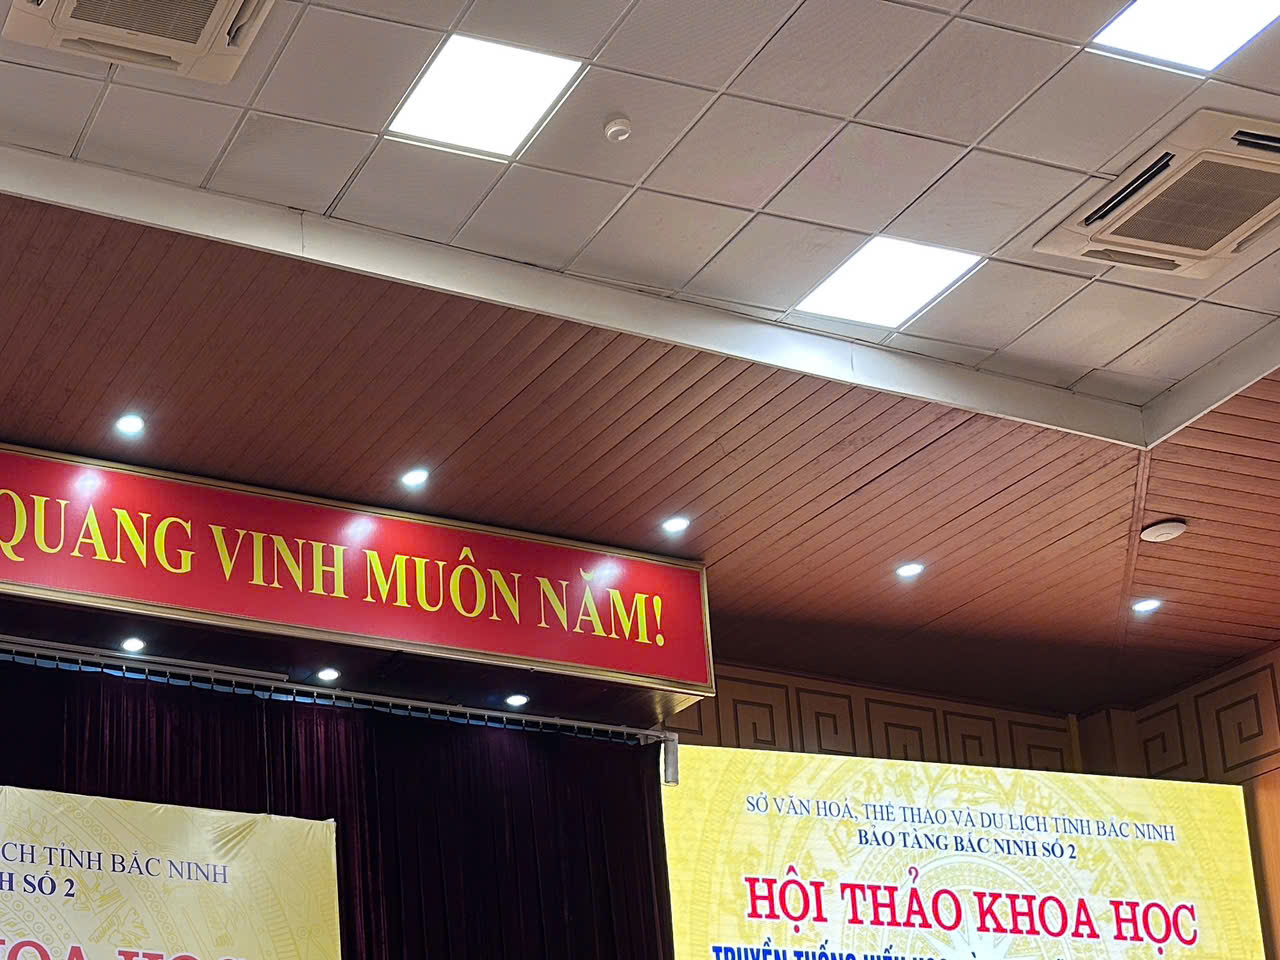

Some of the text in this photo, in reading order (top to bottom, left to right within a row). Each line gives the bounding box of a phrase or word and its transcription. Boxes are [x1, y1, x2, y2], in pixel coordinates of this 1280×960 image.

[209, 524, 348, 600] VINH
[364, 546, 522, 625] MUÔN
[538, 569, 667, 647] NĂM!
[746, 792, 769, 812] SỞ
[773, 796, 811, 816] VĂN
[899, 806, 947, 825] THAO
[951, 807, 976, 828] VÀ
[980, 811, 1005, 829] DU
[1009, 814, 1048, 835] LỊCH
[1133, 823, 1176, 841] NINH
[43, 841, 103, 872] TỈNH
[111, 849, 161, 878] BẮC
[168, 859, 229, 884] NINH
[858, 825, 895, 847] BẢO
[898, 828, 948, 850] TÀNG
[994, 838, 1037, 857] NINH
[1068, 844, 1077, 859] 2
[23, 868, 57, 897] SỐ
[64, 878, 76, 898] 2
[745, 865, 1197, 955] HỘI THẢO KHOA HỌC
